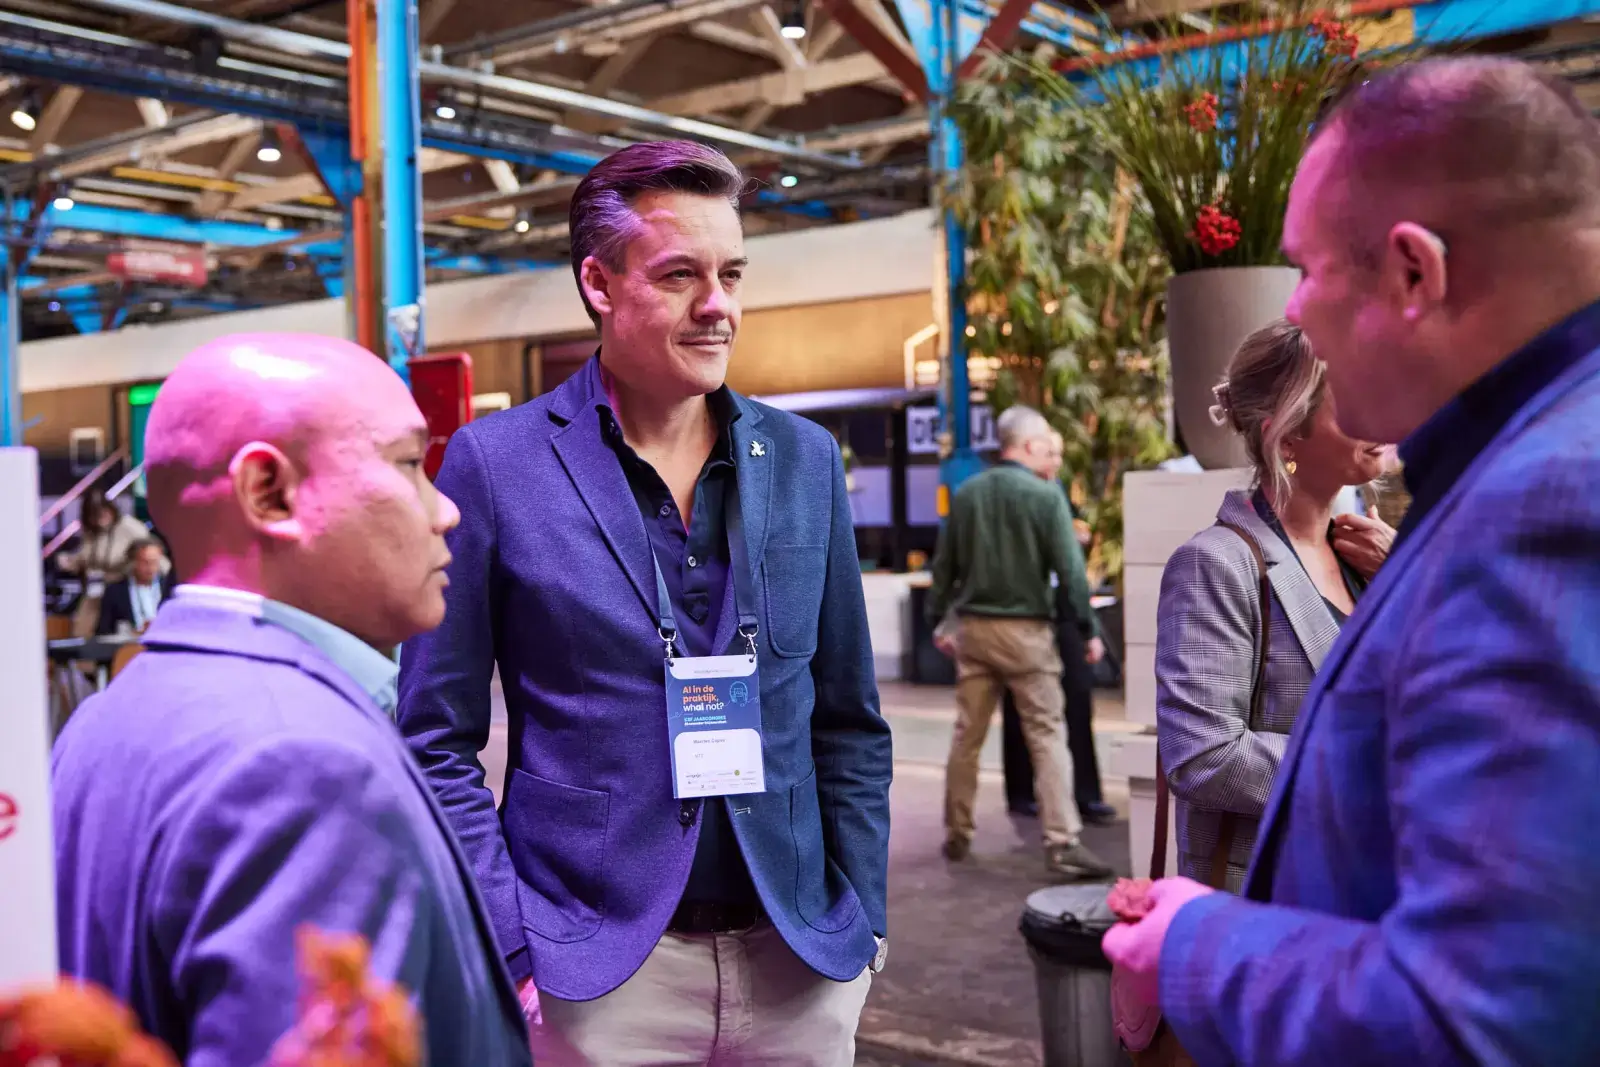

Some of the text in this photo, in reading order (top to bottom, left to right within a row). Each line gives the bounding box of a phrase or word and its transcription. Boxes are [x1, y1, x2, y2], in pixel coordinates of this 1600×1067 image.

[692, 685, 701, 693] in
[683, 694, 718, 704] praktijk,
[706, 702, 724, 711] not?
